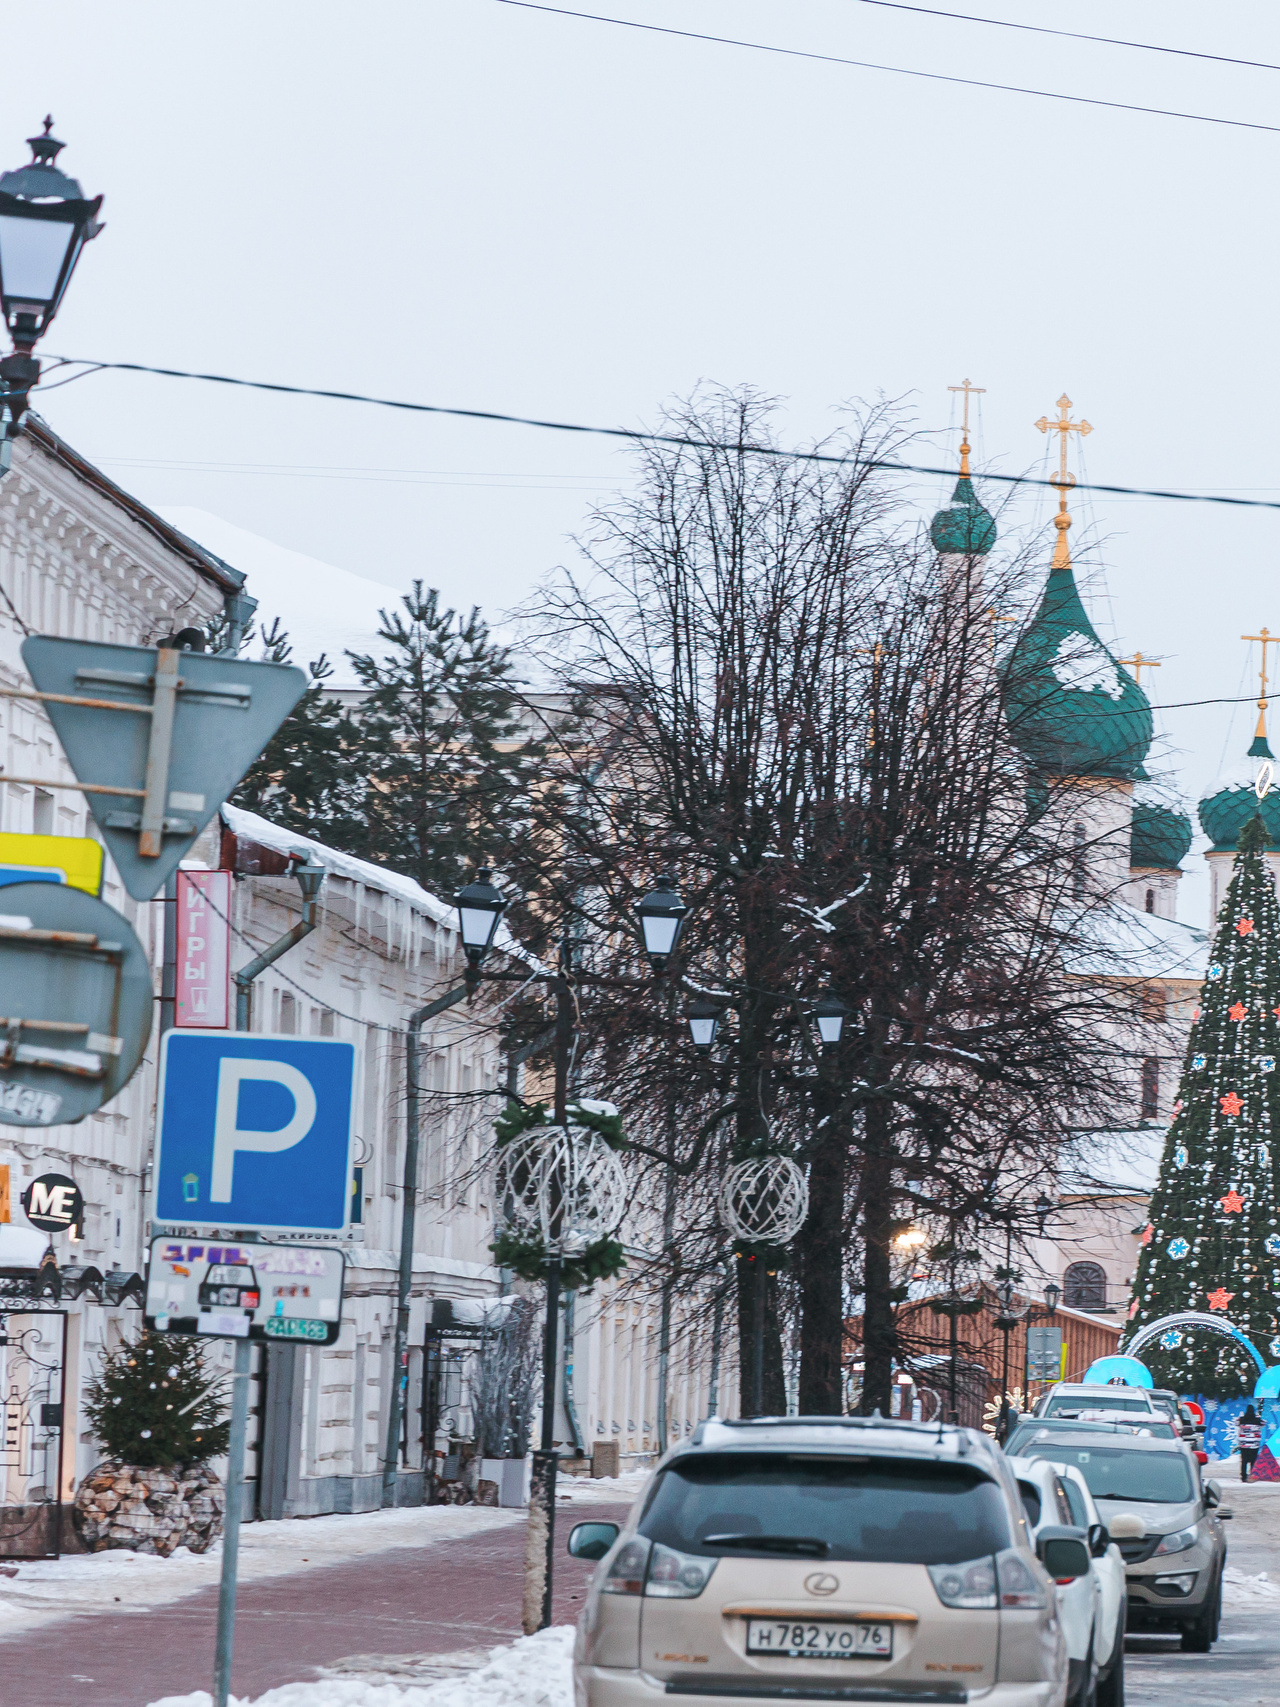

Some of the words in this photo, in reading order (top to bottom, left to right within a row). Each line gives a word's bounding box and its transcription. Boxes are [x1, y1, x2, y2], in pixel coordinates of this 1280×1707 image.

[185, 887, 206, 980] ИГРЫ
[210, 1057, 317, 1203] P
[29, 1182, 76, 1219] ME
[861, 1626, 882, 1644] 76
